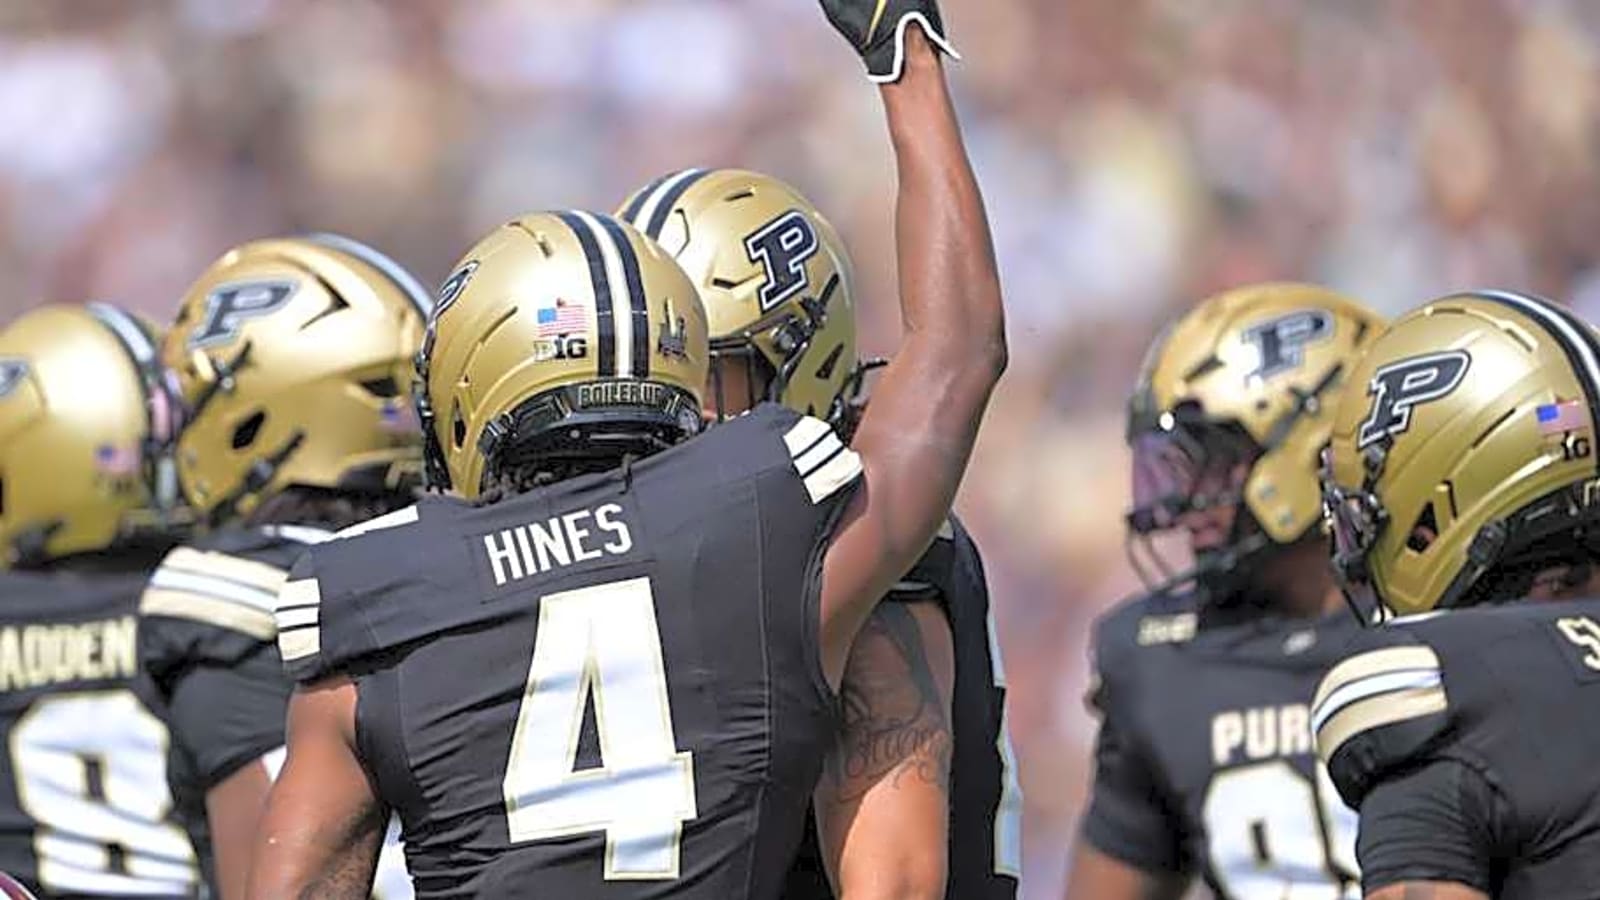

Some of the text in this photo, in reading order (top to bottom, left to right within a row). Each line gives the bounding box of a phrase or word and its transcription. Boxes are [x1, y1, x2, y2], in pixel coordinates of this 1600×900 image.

[745, 209, 819, 312] P
[187, 275, 301, 350] P
[1241, 309, 1334, 387] P
[578, 381, 639, 408] BOILER
[1357, 349, 1471, 451] P
[484, 503, 633, 585] HINES
[0, 615, 137, 692] ADDEN
[503, 576, 697, 880] 4
[1211, 703, 1313, 764] PUR
[9, 688, 199, 895] 8
